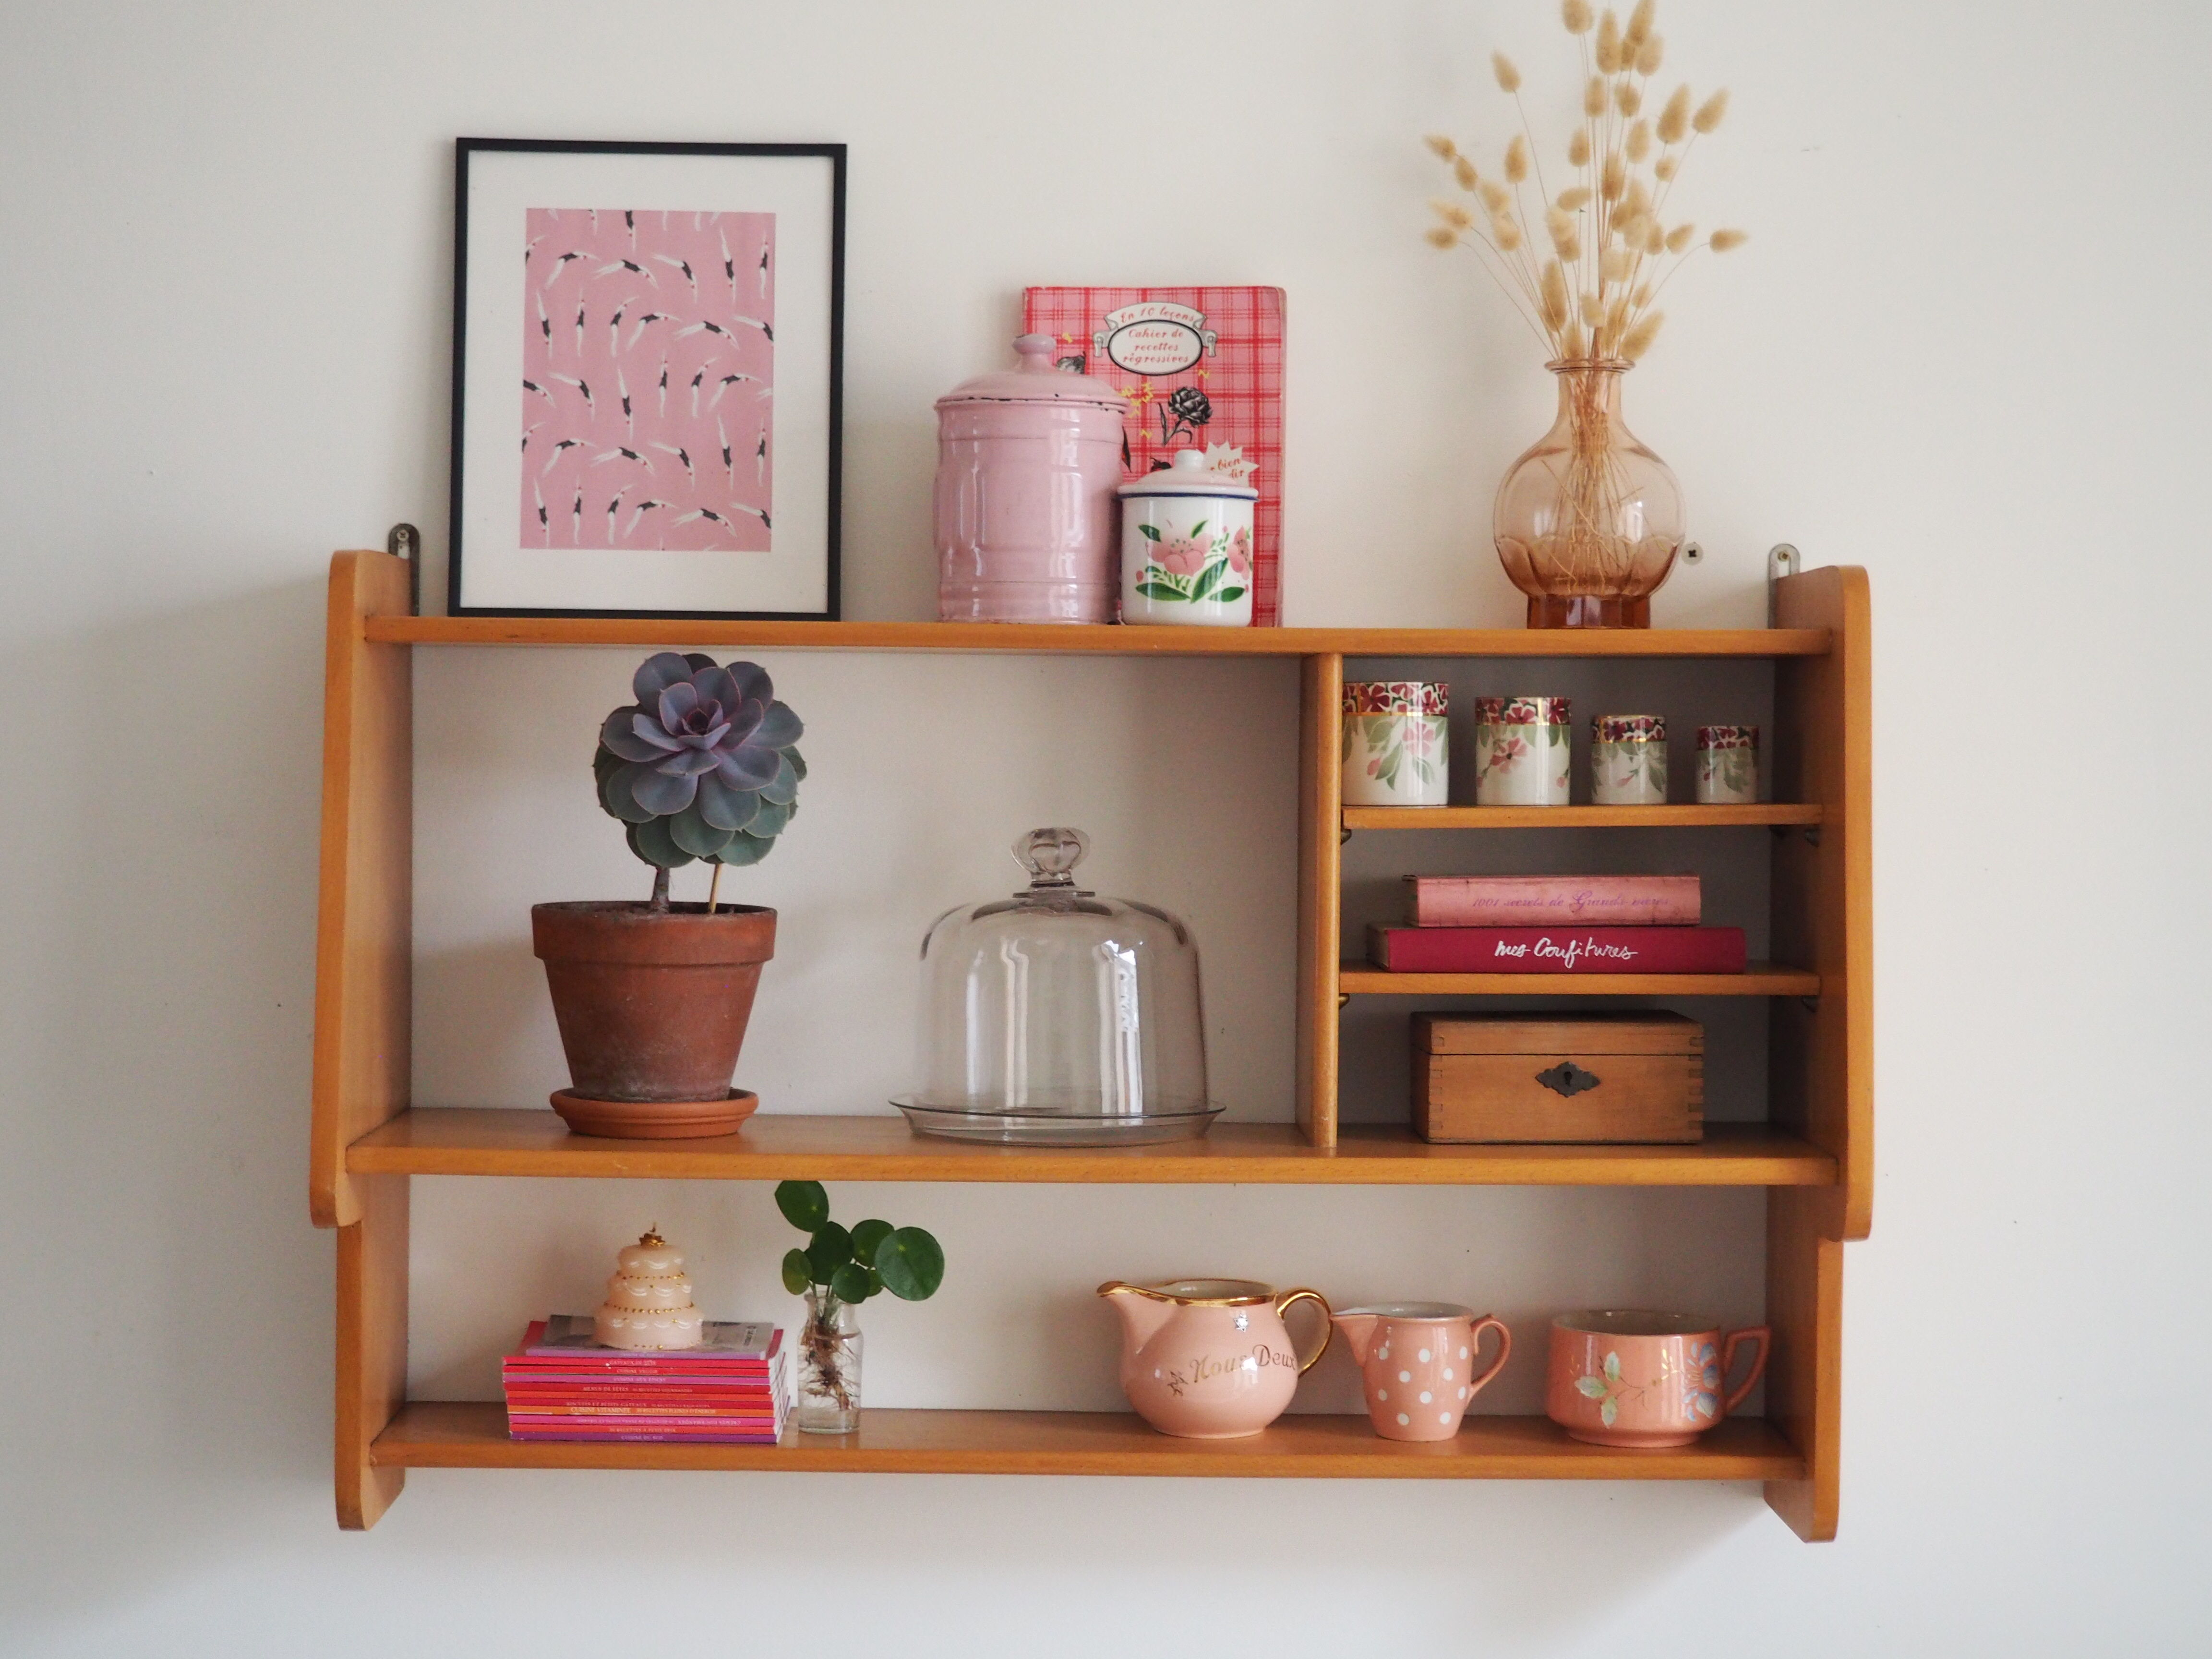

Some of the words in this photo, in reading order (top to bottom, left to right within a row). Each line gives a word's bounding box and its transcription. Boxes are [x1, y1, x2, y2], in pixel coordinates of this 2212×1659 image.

[1120, 313, 1134, 323] En
[1141, 307, 1154, 316] 10
[1129, 328, 1167, 338] Cahier
[1171, 328, 1183, 338] de
[1134, 342, 1179, 351] recettes
[1123, 353, 1189, 366] régressives
[1218, 458, 1241, 471] bien
[1473, 898, 1500, 907] 1001
[1549, 893, 1564, 907] de
[1534, 937, 1639, 969] Confitures
[1252, 1344, 1296, 1370] Deux
